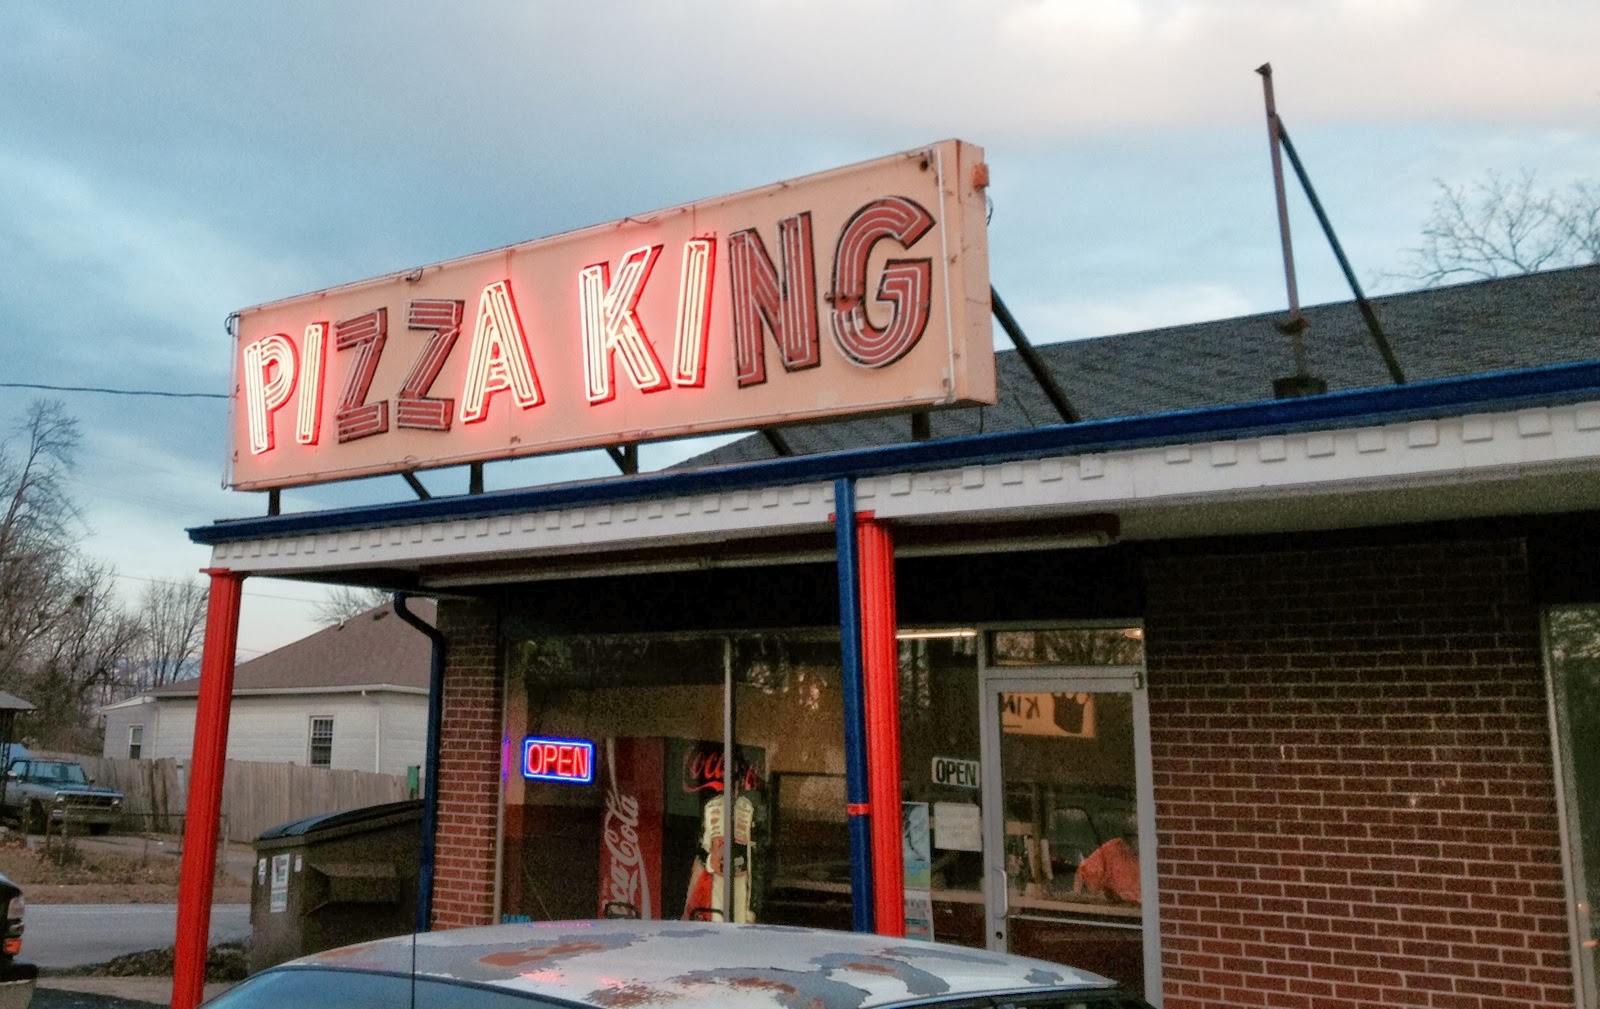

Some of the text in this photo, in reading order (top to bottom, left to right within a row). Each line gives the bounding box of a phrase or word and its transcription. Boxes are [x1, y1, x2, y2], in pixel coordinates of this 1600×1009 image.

[243, 196, 935, 455] PIZZA KING
[527, 743, 589, 778] OPEN
[935, 758, 977, 787] OPEN
[602, 791, 644, 920] oca-Cola
